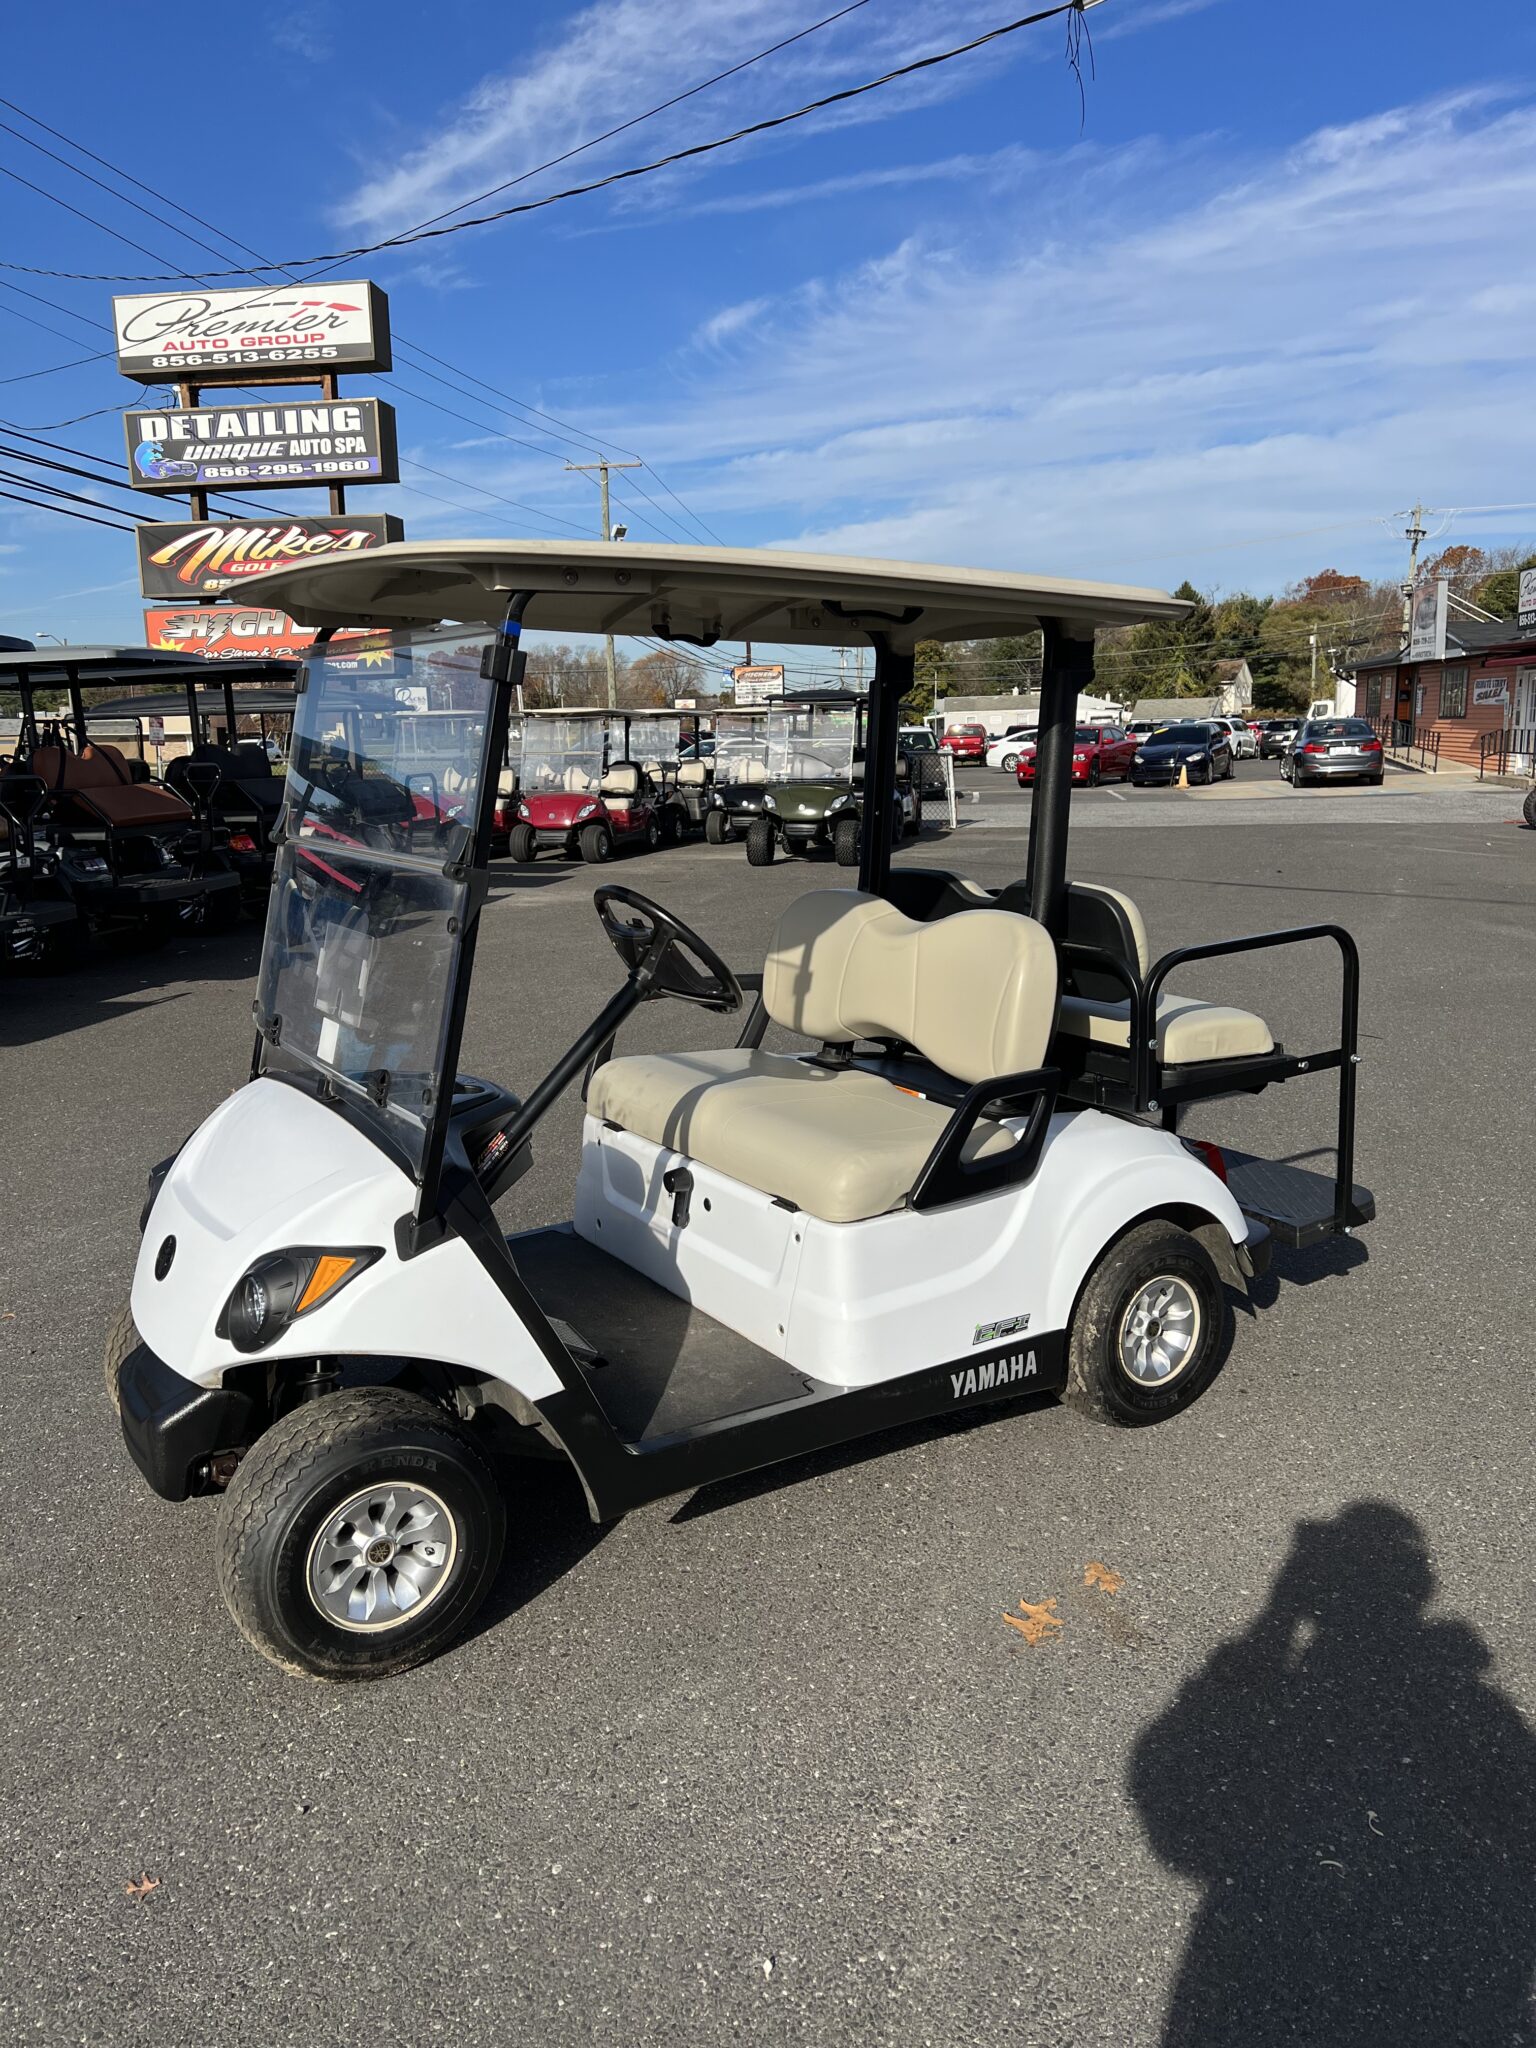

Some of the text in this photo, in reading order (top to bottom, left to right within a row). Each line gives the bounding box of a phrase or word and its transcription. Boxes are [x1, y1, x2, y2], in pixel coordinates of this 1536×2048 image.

[122, 298, 349, 343] Premier
[162, 333, 326, 352] AUTO GROUP
[152, 347, 338, 368] 856-513-6255
[139, 406, 362, 442] DETAILING
[289, 438, 331, 457] AUTO
[335, 437, 367, 455] SPA
[203, 460, 371, 479] 856-295-1960
[230, 562, 284, 573] GOLF
[160, 611, 287, 646] HIGH
[220, 647, 259, 659] Stereo
[950, 1350, 1037, 1399] YAMAHA
